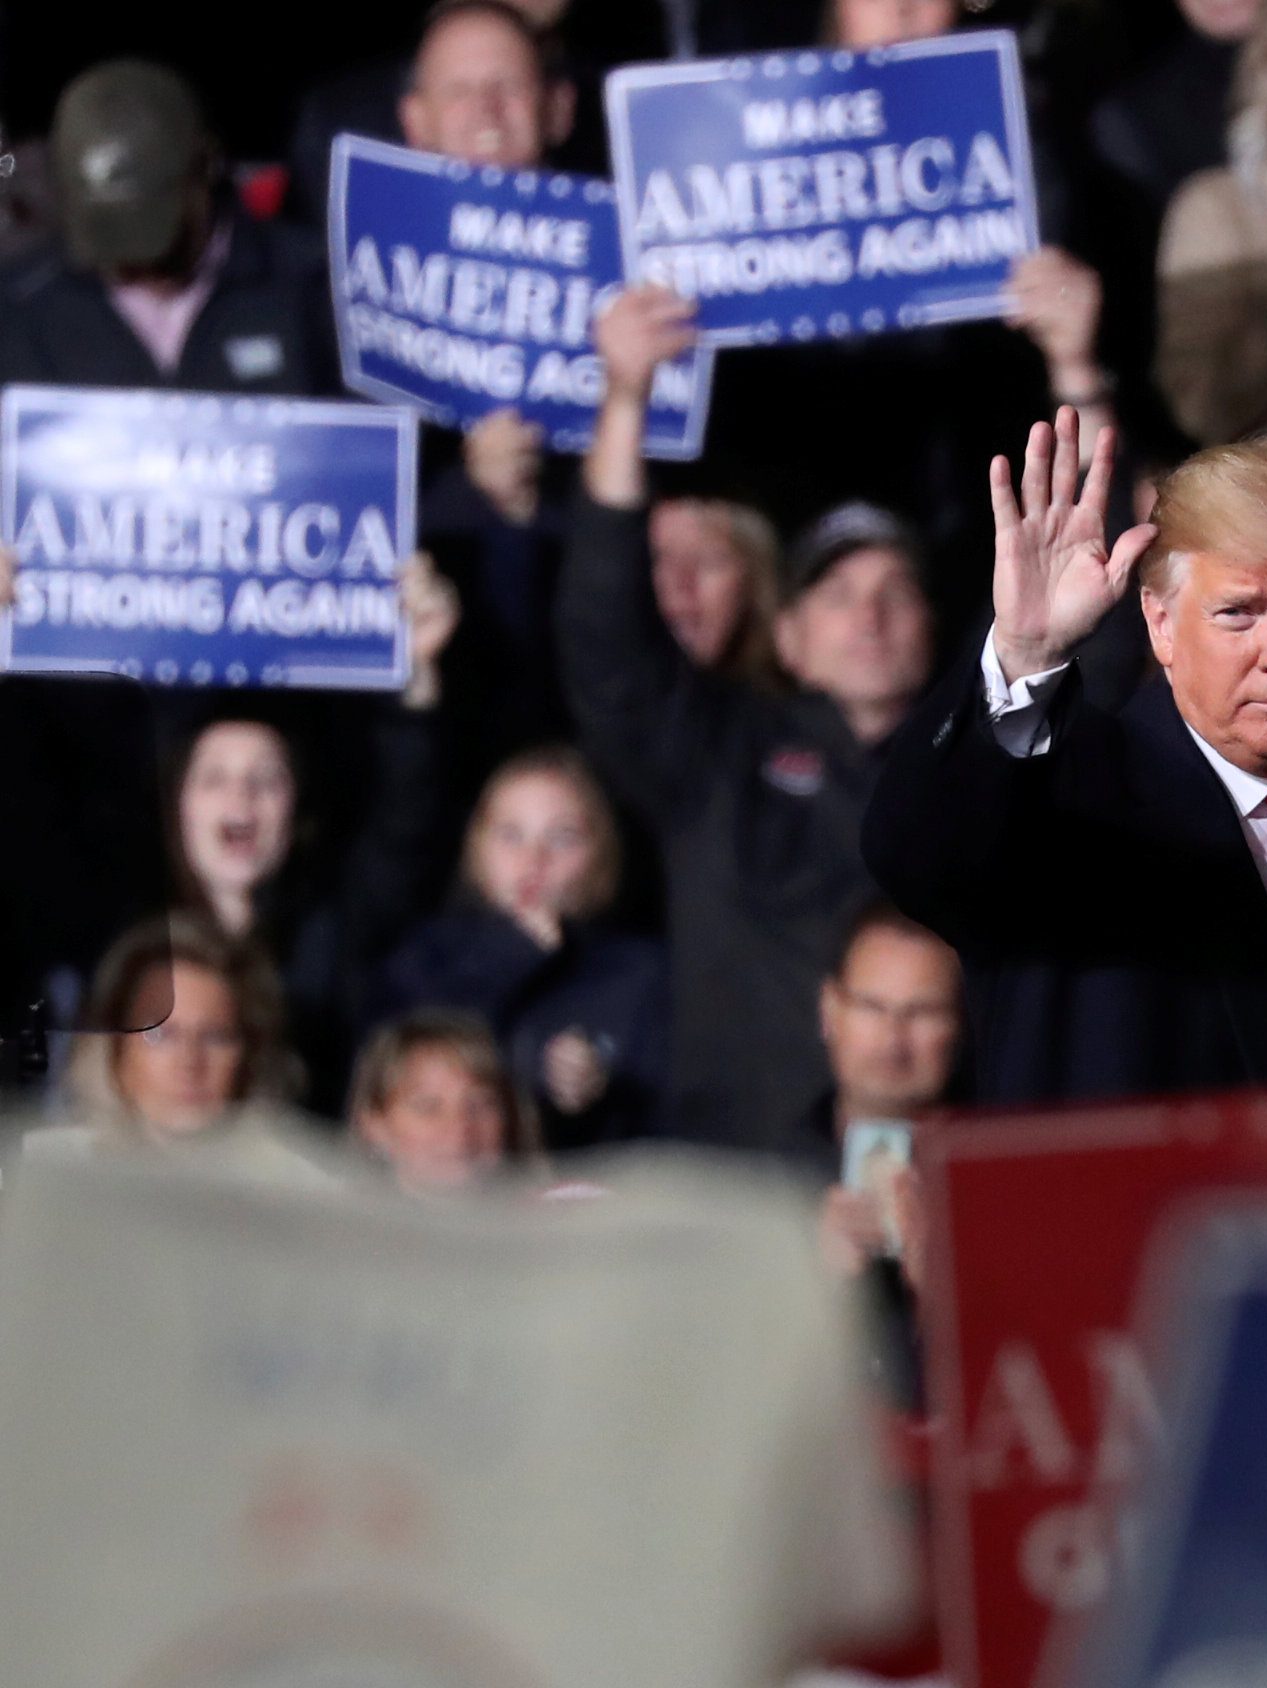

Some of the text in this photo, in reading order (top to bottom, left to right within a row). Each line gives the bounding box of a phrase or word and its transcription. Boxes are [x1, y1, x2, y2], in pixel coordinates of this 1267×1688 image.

[742, 88, 886, 150] MAKE
[636, 131, 1014, 240] AMERICA
[448, 201, 591, 268] MAKE
[637, 205, 1026, 302] STRONG AGAIN
[347, 235, 622, 349] AMERI
[14, 492, 399, 580] AMERICA
[14, 568, 397, 638] STRONG AGAIN
